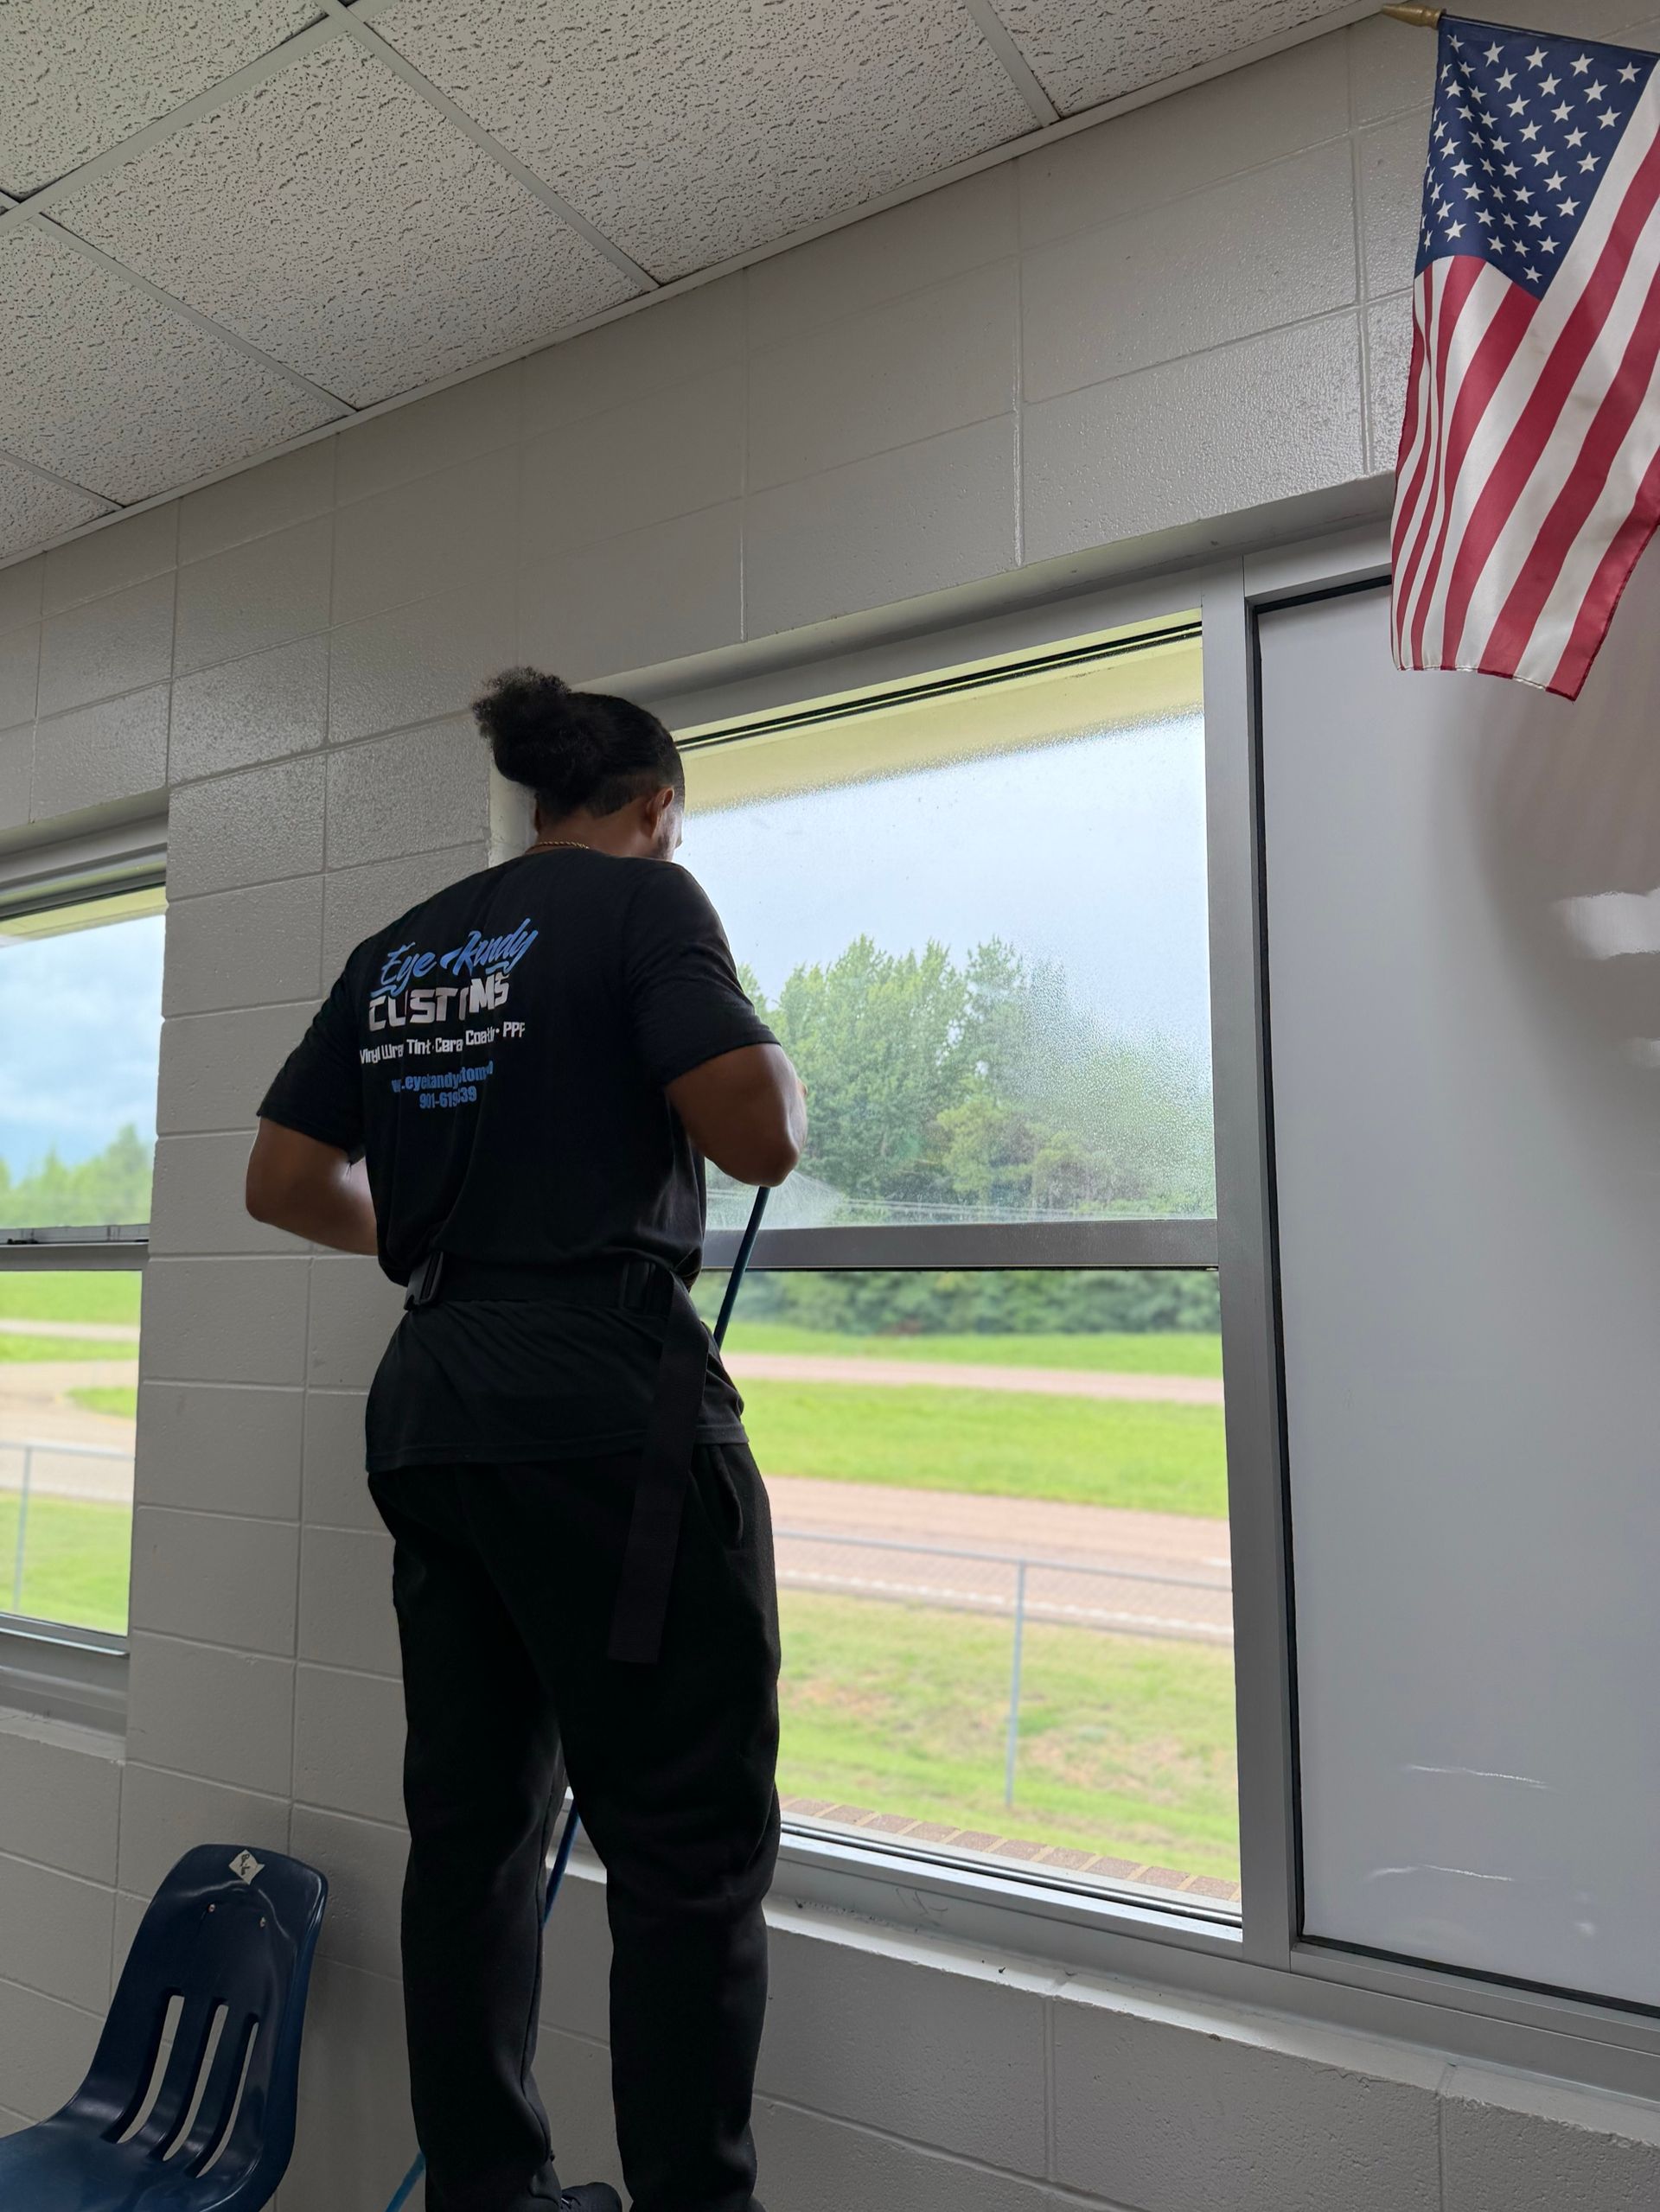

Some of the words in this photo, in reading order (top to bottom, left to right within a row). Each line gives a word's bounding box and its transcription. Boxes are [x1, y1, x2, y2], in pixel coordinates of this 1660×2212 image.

[370, 941, 438, 1000] Eye
[405, 1038, 431, 1055] Tint
[502, 1020, 527, 1038] PPF
